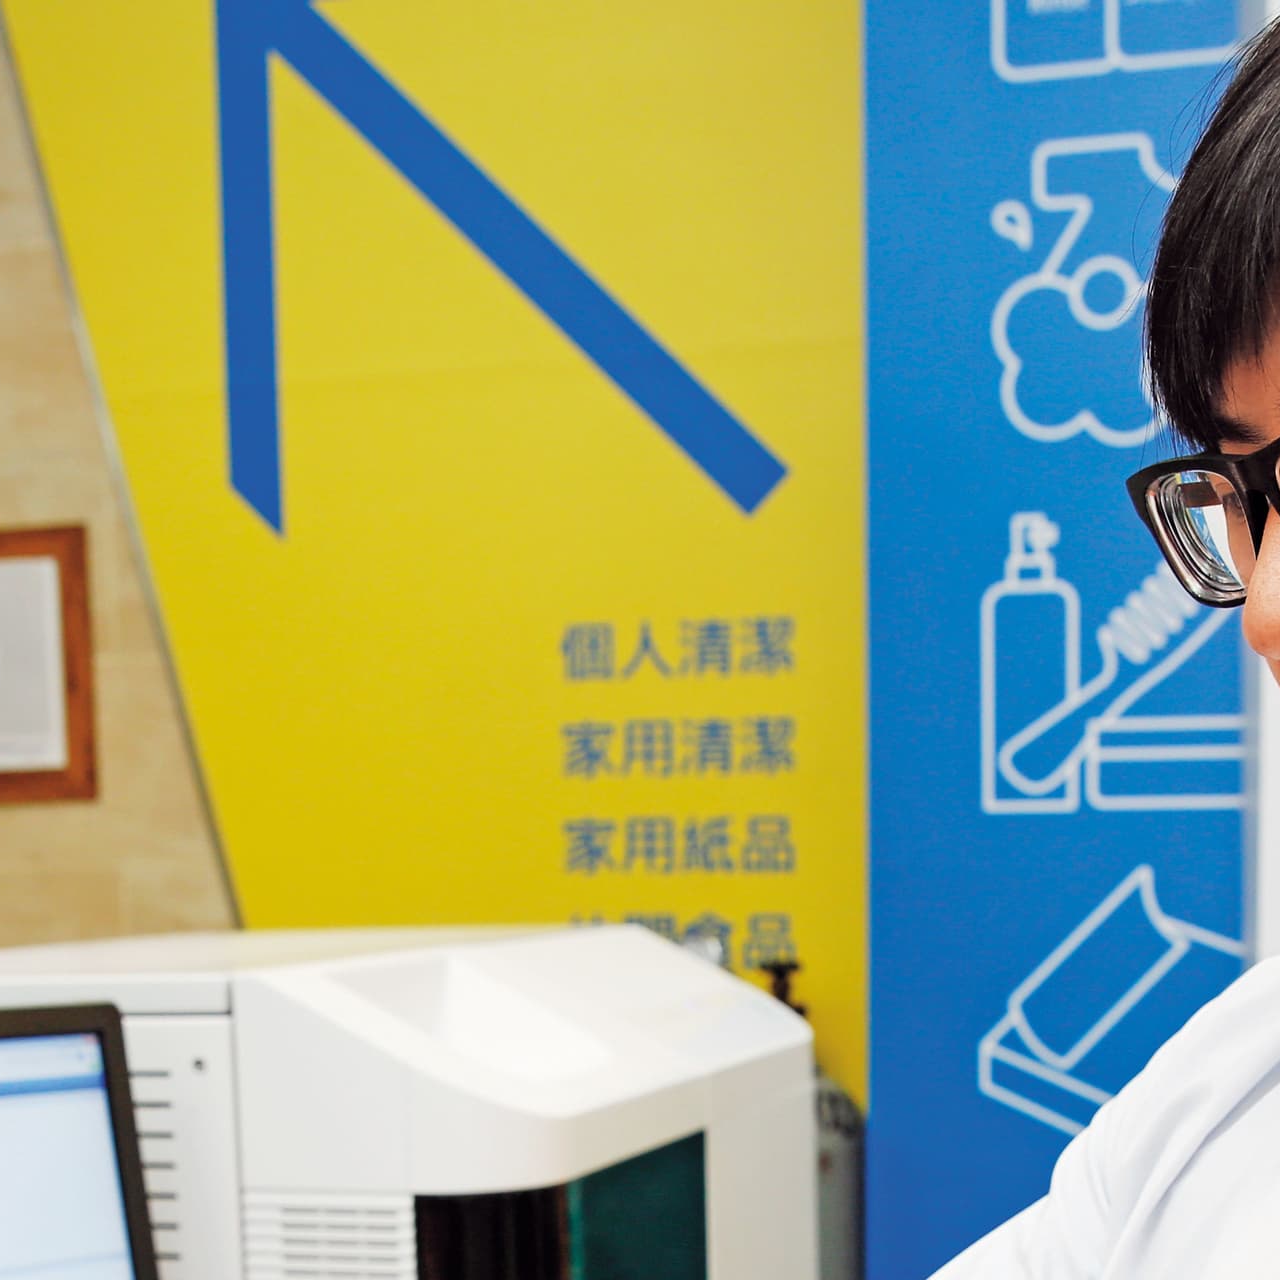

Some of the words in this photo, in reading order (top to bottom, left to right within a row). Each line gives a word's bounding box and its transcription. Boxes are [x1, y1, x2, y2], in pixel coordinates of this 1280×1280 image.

[561, 615, 796, 682] 個人清潔
[561, 715, 796, 779] 家用清潔
[561, 814, 797, 875] 家用紙品
